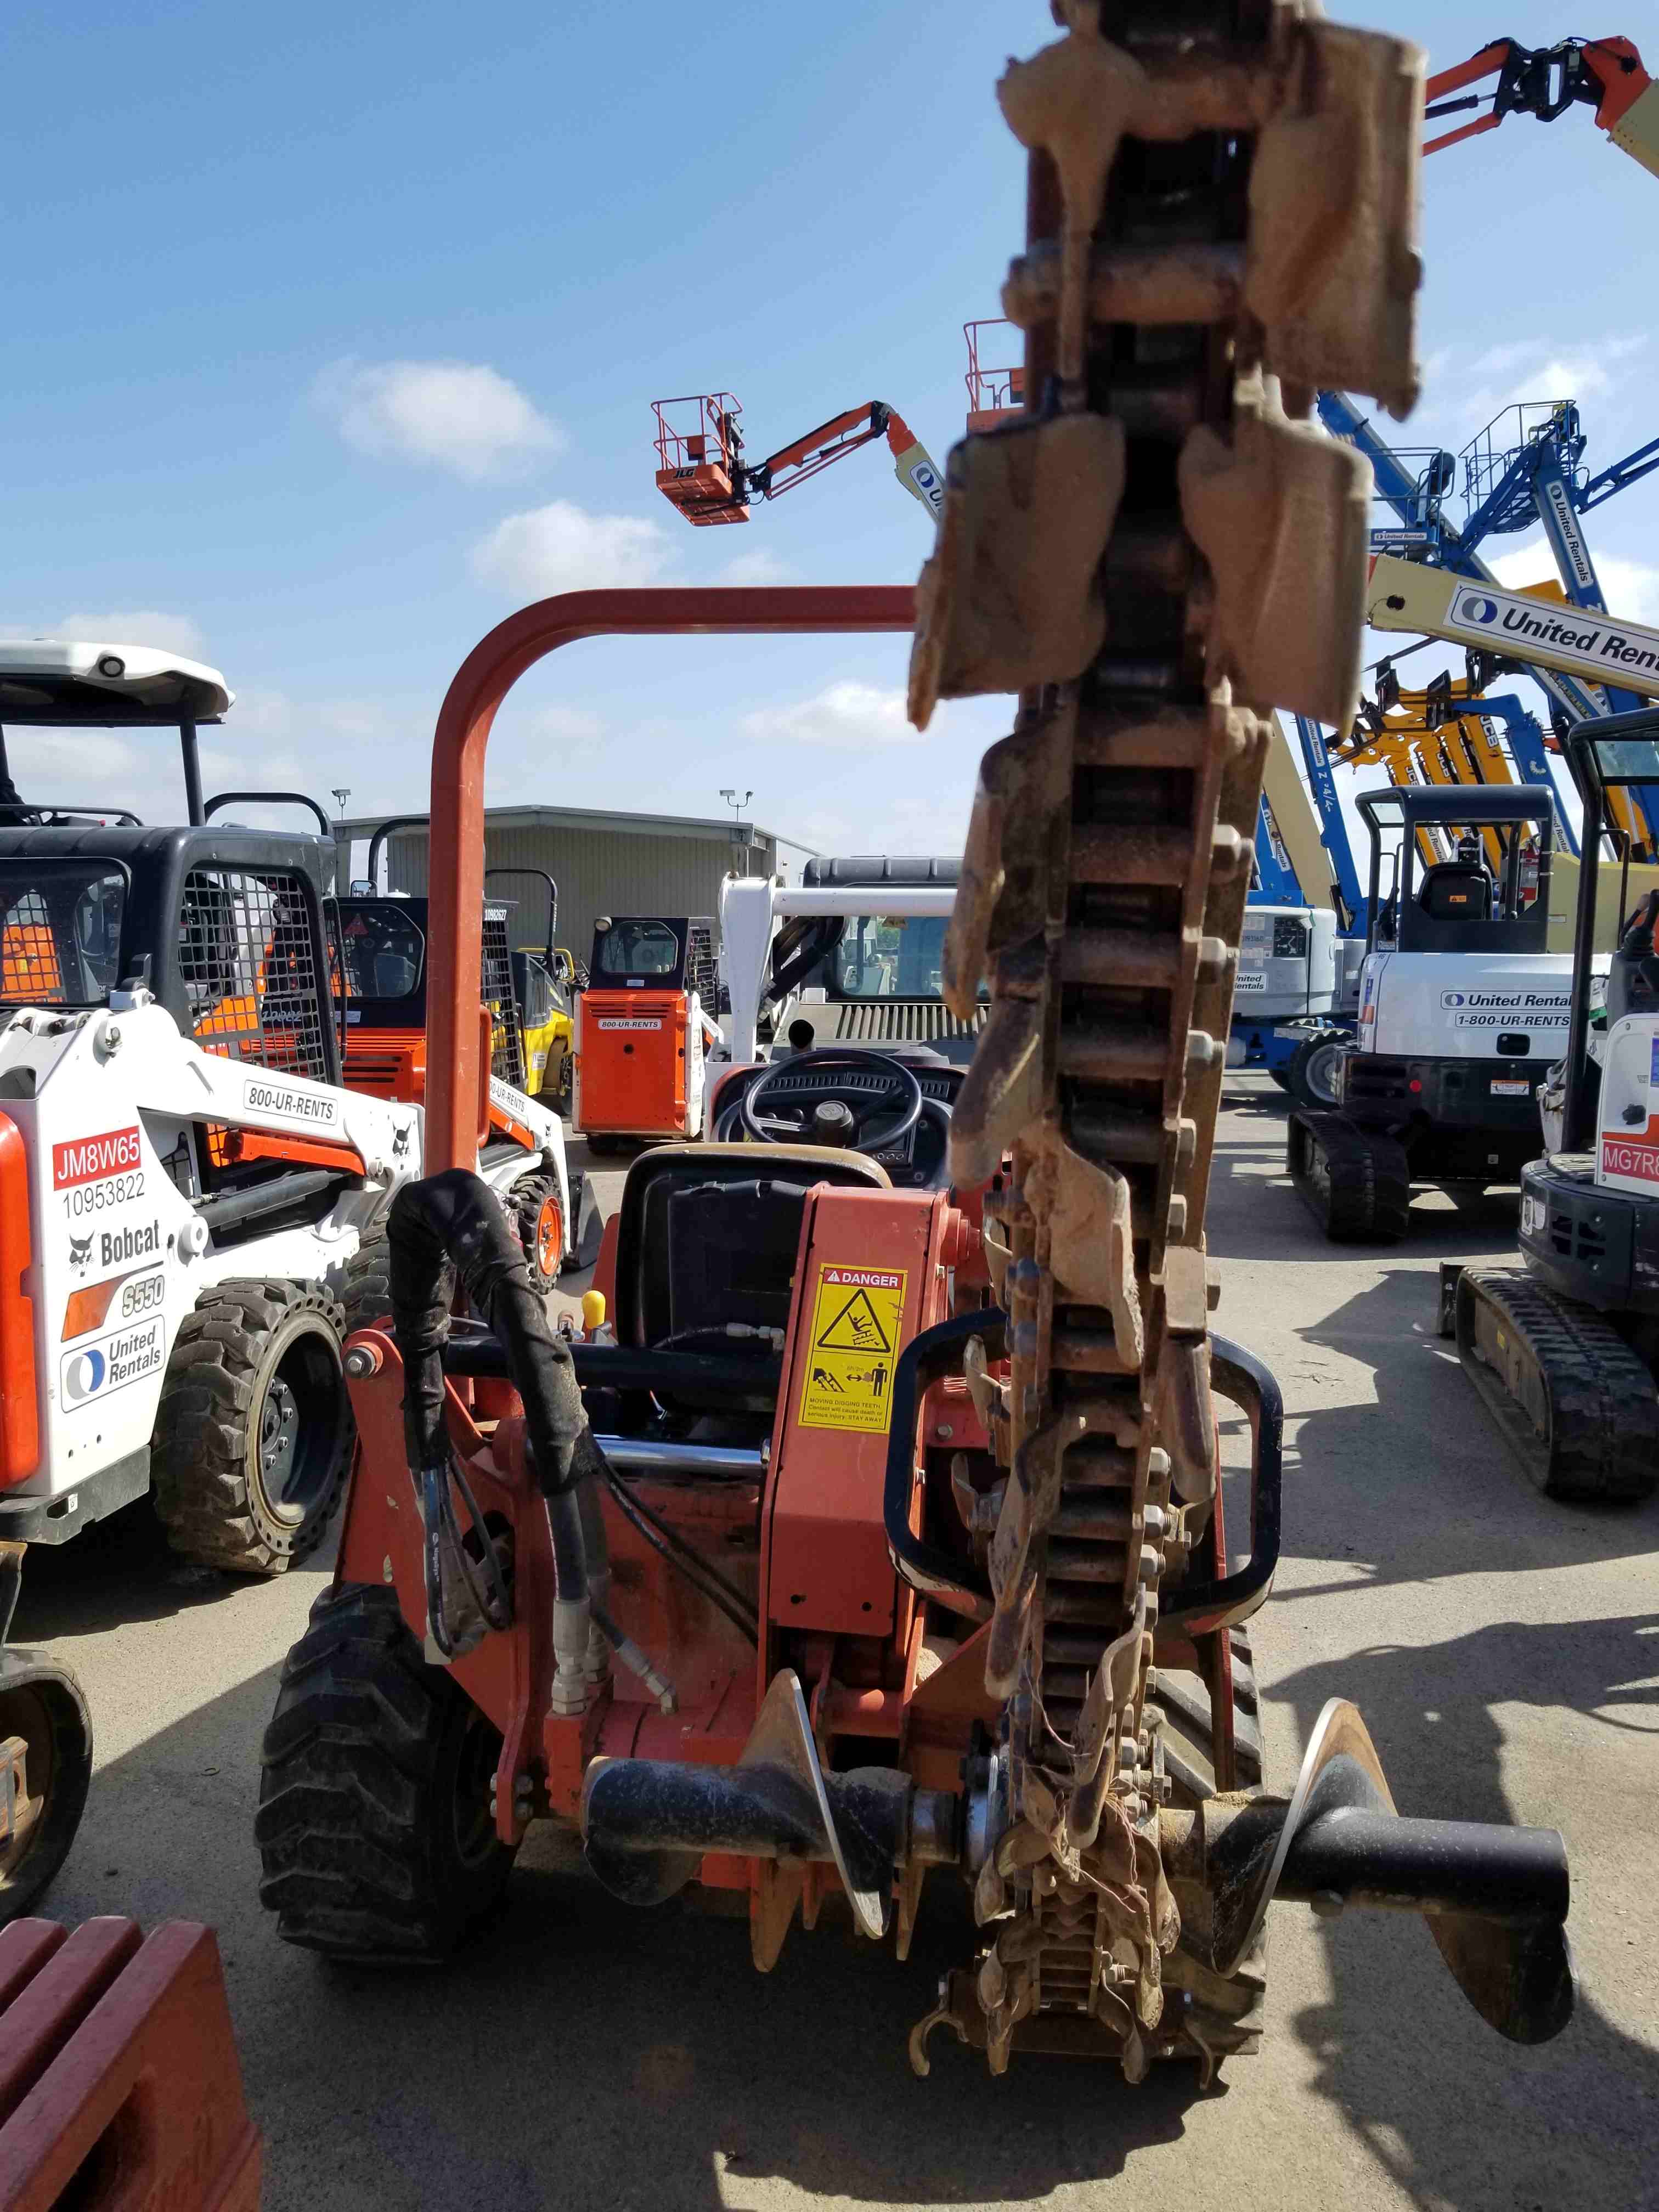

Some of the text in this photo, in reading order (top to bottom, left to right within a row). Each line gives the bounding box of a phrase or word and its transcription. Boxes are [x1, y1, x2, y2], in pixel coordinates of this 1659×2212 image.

[673, 467, 695, 479] JLG
[1555, 501, 1589, 582] United Rentals
[1502, 608, 1601, 652] United
[1307, 719, 1323, 764] United Rentals
[1480, 715, 1499, 748] JCB
[1468, 994, 1572, 1007] United Rental
[1458, 1015, 1570, 1026] 1-800-UR-RENTS
[249, 1087, 334, 1119] 800-UR-RENTS
[58, 1133, 139, 1180] JM8W65
[63, 1172, 145, 1218] 10953822
[101, 1219, 160, 1267] Bobcat
[122, 1274, 165, 1318] S550
[842, 1272, 899, 1287] DANGER
[109, 1325, 156, 1362] United
[109, 1347, 161, 1384] Rentals
